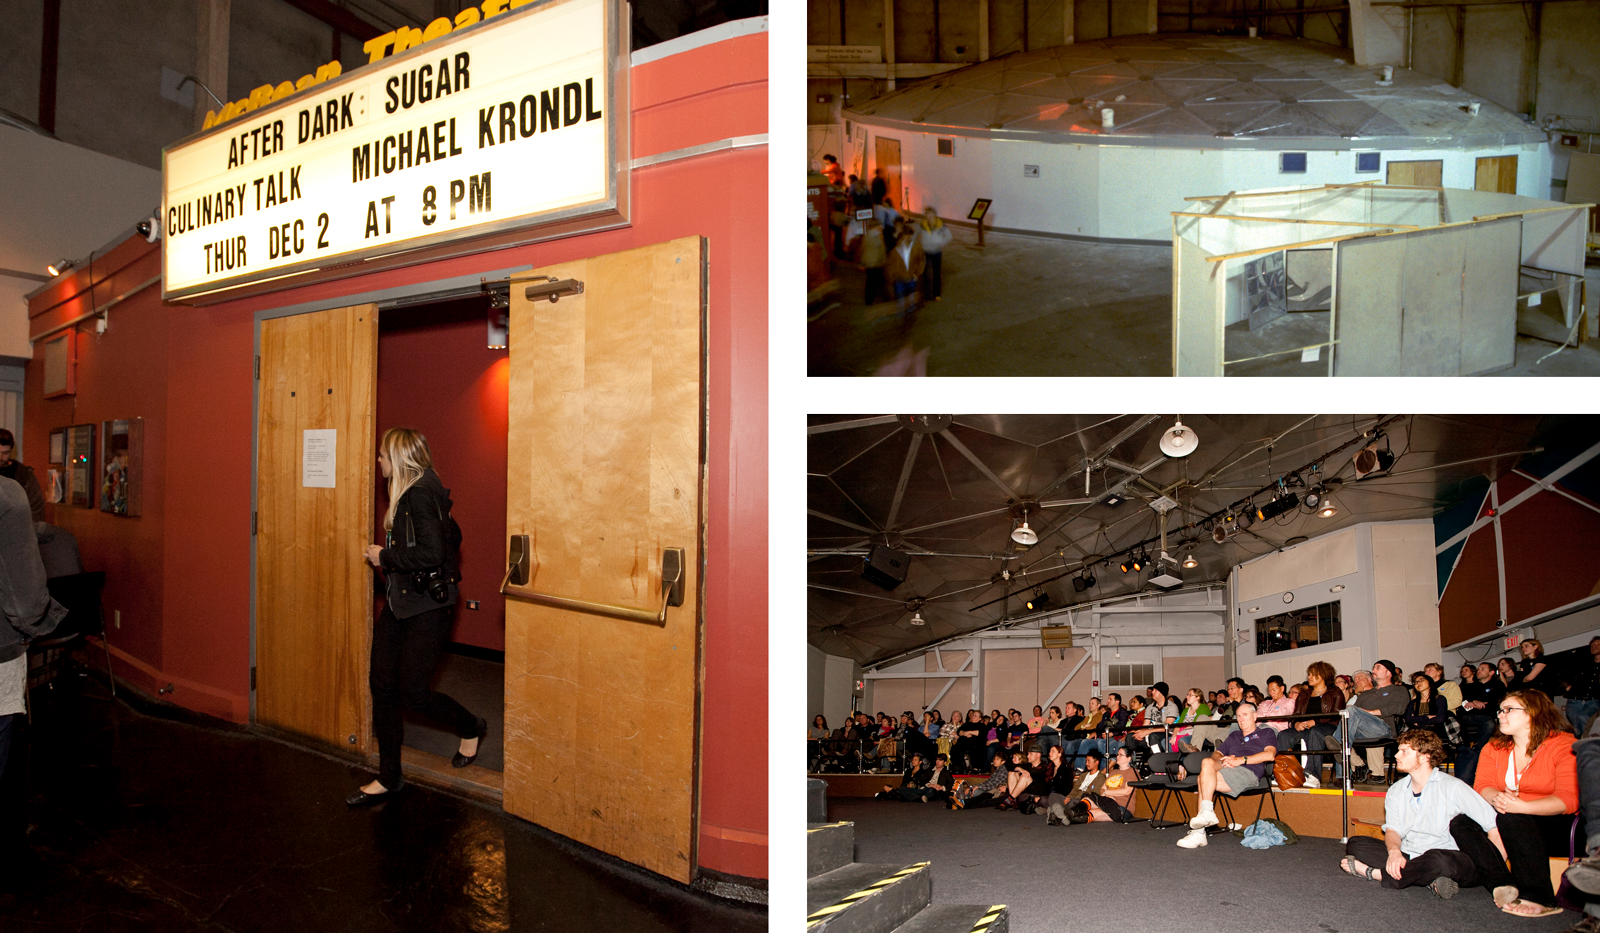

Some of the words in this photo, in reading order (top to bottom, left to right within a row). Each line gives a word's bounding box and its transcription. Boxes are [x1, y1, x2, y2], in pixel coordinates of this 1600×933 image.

[201, 60, 342, 131] McBean
[227, 119, 284, 170] AFTER
[385, 51, 470, 115] SUGAR
[168, 183, 246, 237] CULINARY
[254, 165, 302, 211] TALK
[353, 117, 462, 183] MICHAEL
[479, 77, 602, 149] KRONDL
[204, 235, 247, 275] THUR
[269, 219, 305, 260] DEC
[317, 212, 329, 250] 2
[365, 195, 395, 239] AT
[422, 185, 437, 226] 8
[450, 171, 492, 220] PM
[1506, 636, 1518, 648] EXIT
